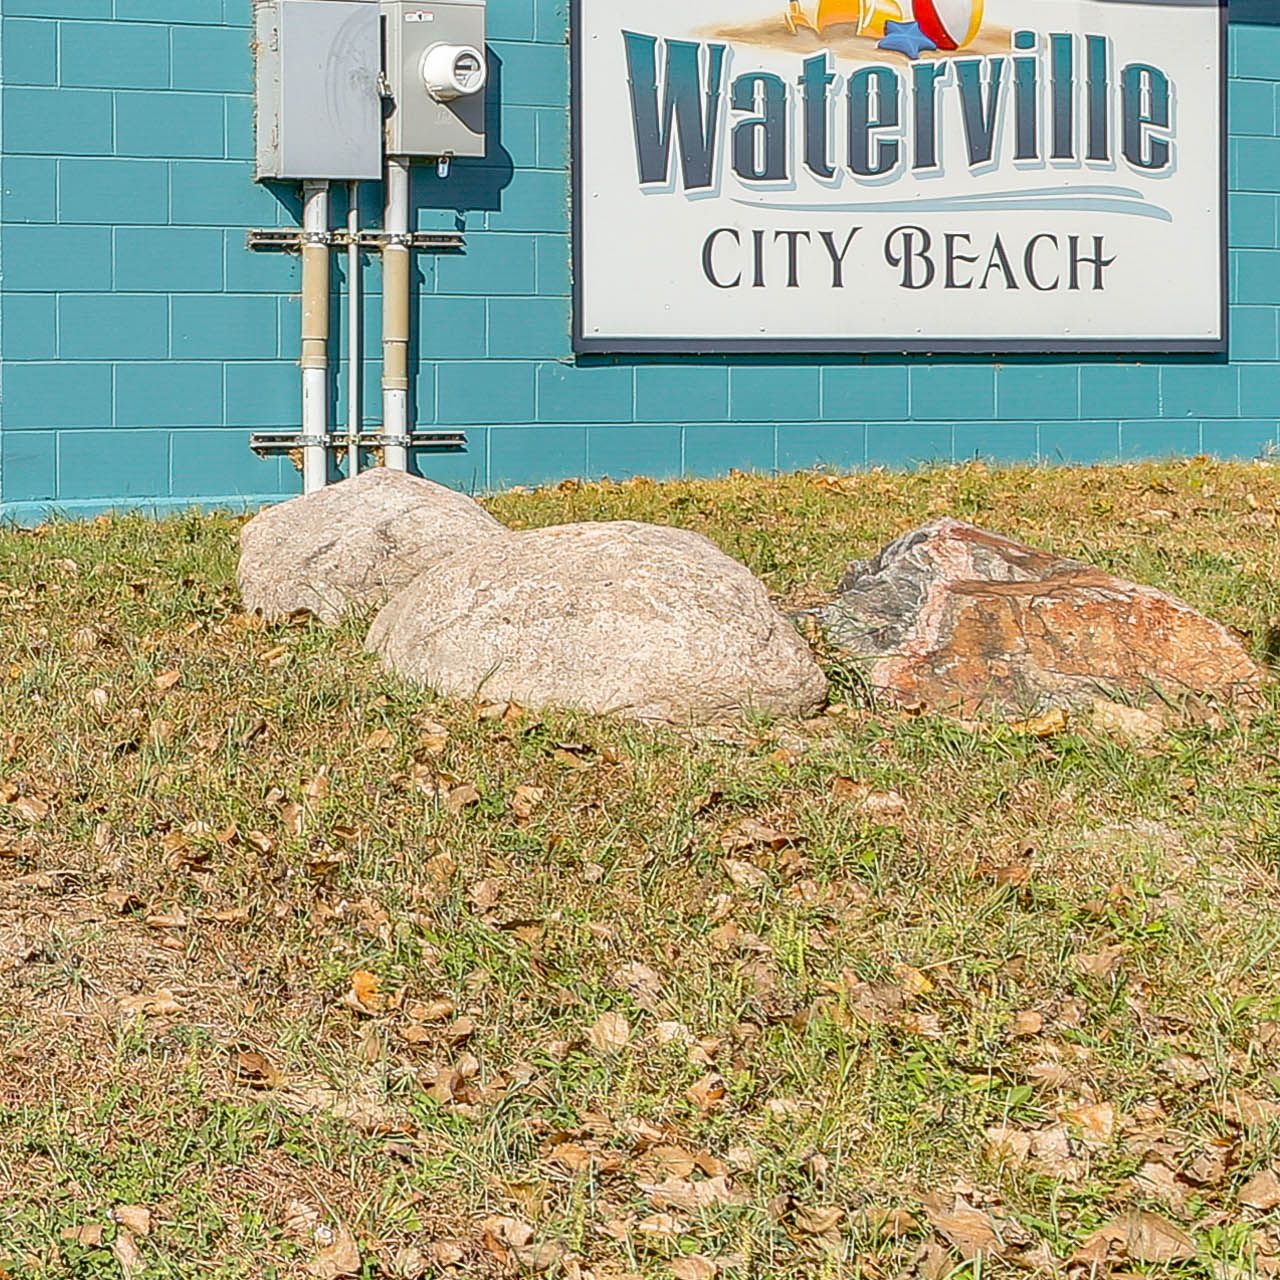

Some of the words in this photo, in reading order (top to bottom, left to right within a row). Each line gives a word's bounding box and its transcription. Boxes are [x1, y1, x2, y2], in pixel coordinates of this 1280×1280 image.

[621, 28, 1175, 195] Waterville
[701, 227, 863, 290] CITY
[883, 225, 1117, 291] BEACH
